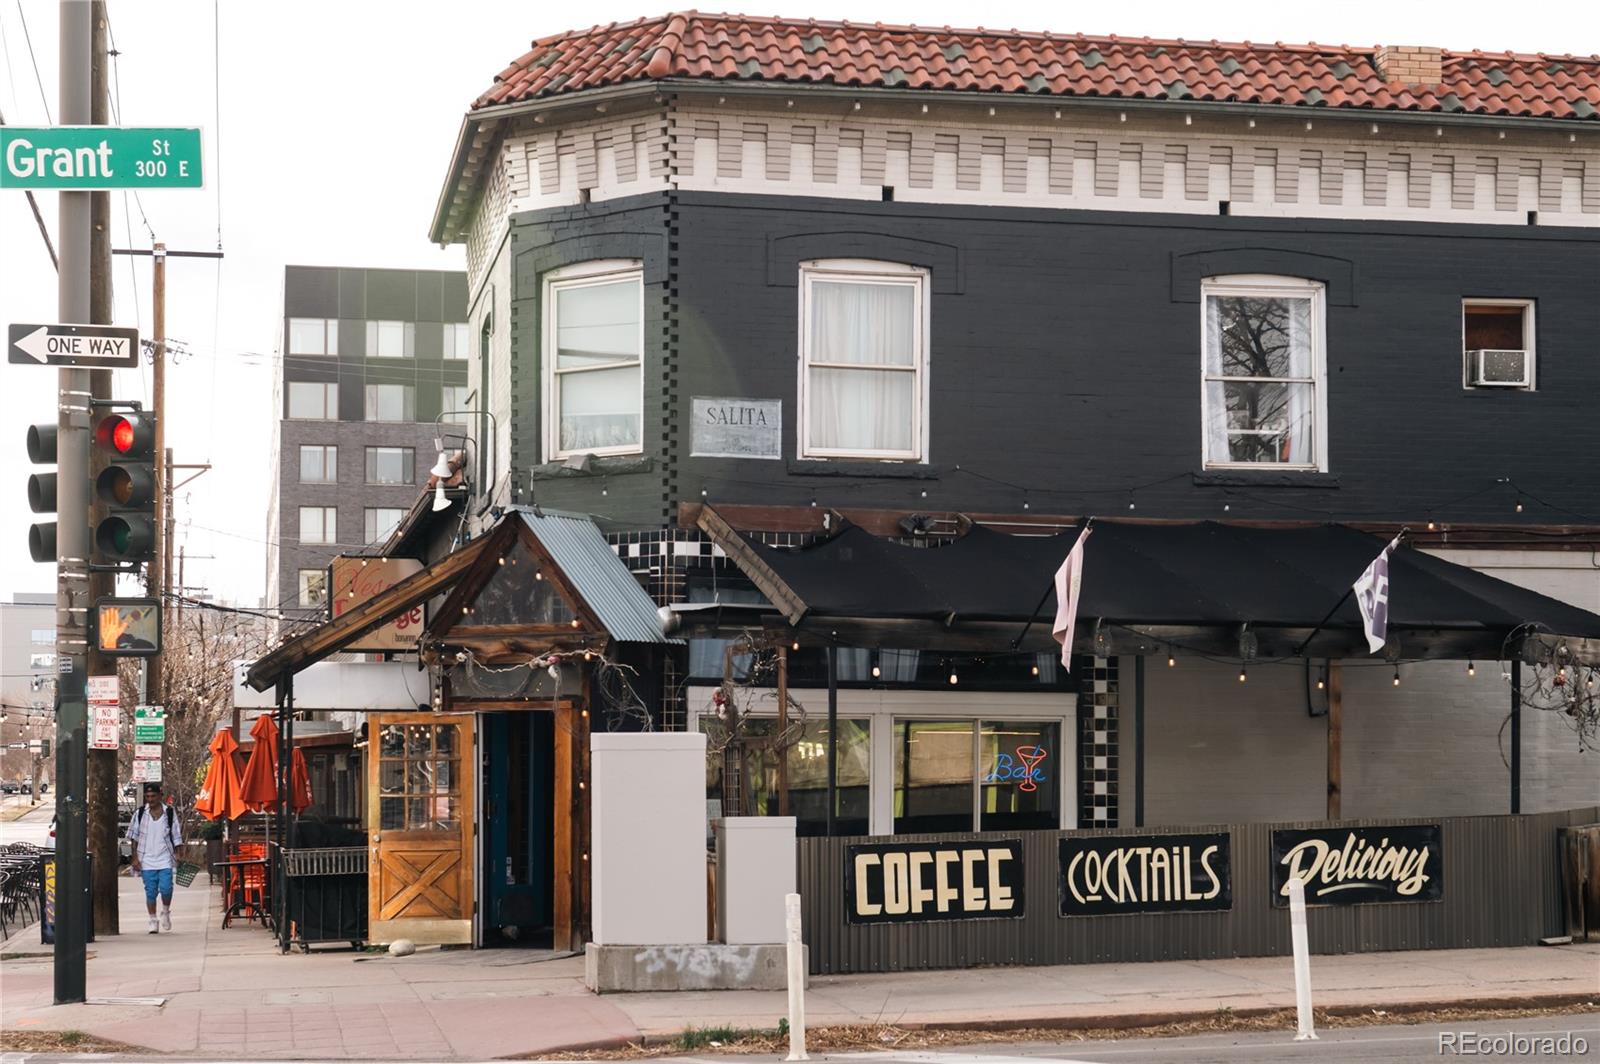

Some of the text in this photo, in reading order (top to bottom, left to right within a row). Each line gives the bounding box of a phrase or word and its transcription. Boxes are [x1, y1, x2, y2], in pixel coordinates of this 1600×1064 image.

[152, 139, 170, 156] St
[6, 139, 113, 178] Grant
[135, 160, 189, 177] 300 E
[47, 338, 124, 356] ONE WAY
[706, 406, 767, 425] SALITA
[102, 709, 111, 717] NO
[96, 719, 117, 727] PARKING
[986, 753, 1046, 782] Bar
[1280, 832, 1430, 897] Delicious
[855, 849, 1015, 915] COFFEE
